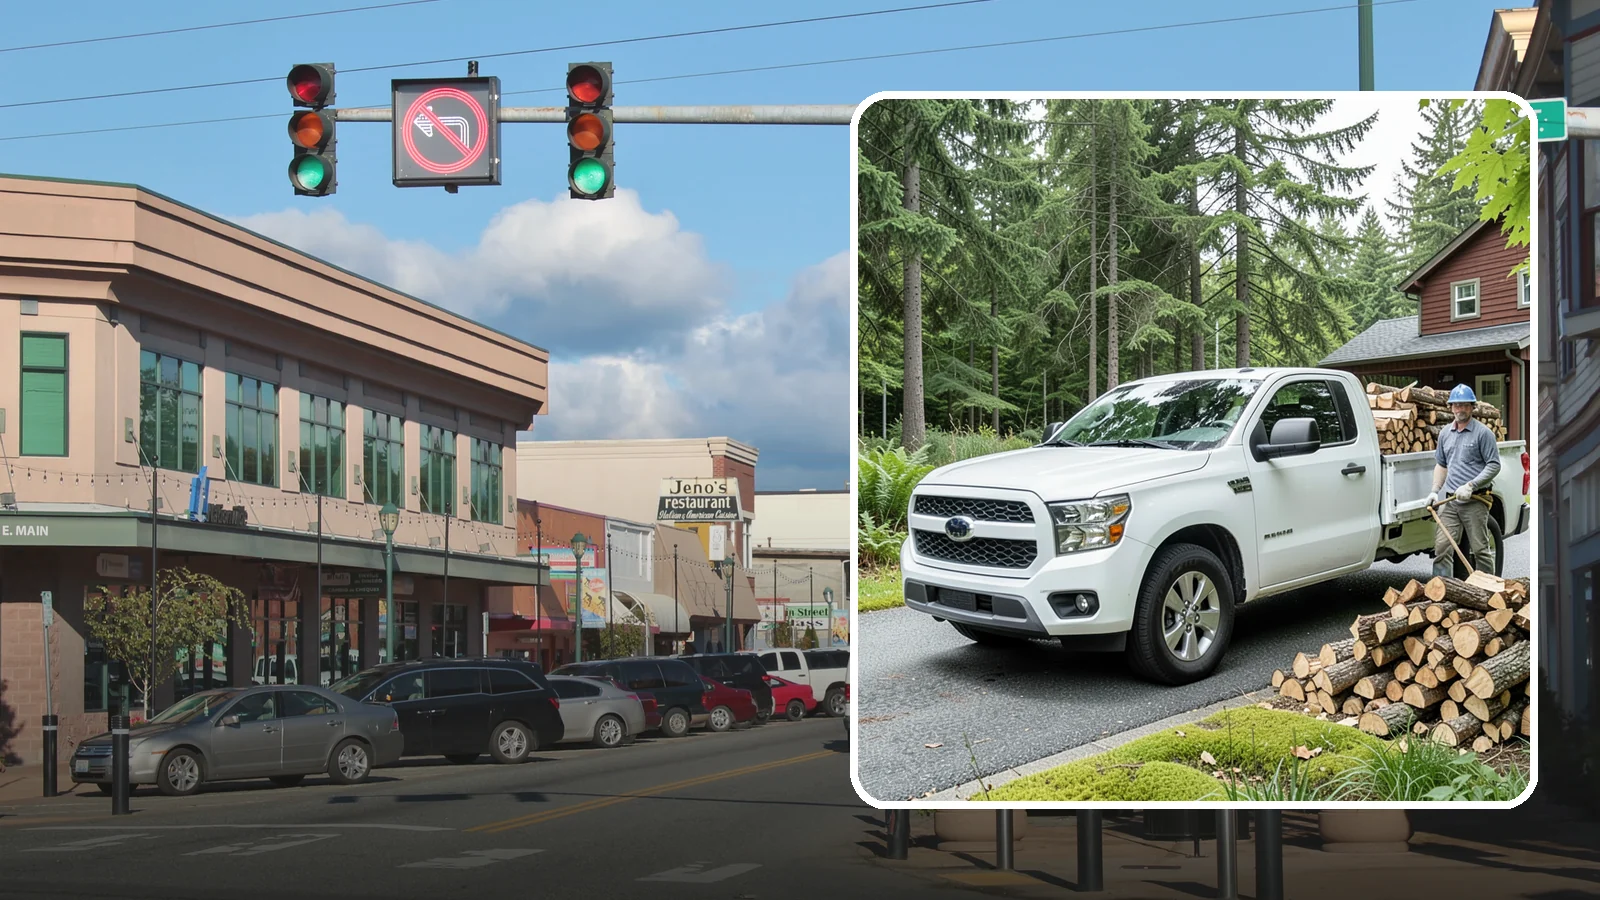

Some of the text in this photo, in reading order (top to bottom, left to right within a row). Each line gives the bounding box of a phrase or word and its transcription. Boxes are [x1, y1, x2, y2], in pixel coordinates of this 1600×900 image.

[670, 480, 727, 494] Jeno's
[665, 496, 731, 509] restaurant
[658, 510, 682, 519] Italian
[686, 509, 714, 519] American
[715, 509, 738, 519] Cuisine
[2, 525, 49, 536] E. MAIN
[797, 608, 828, 616] Street
